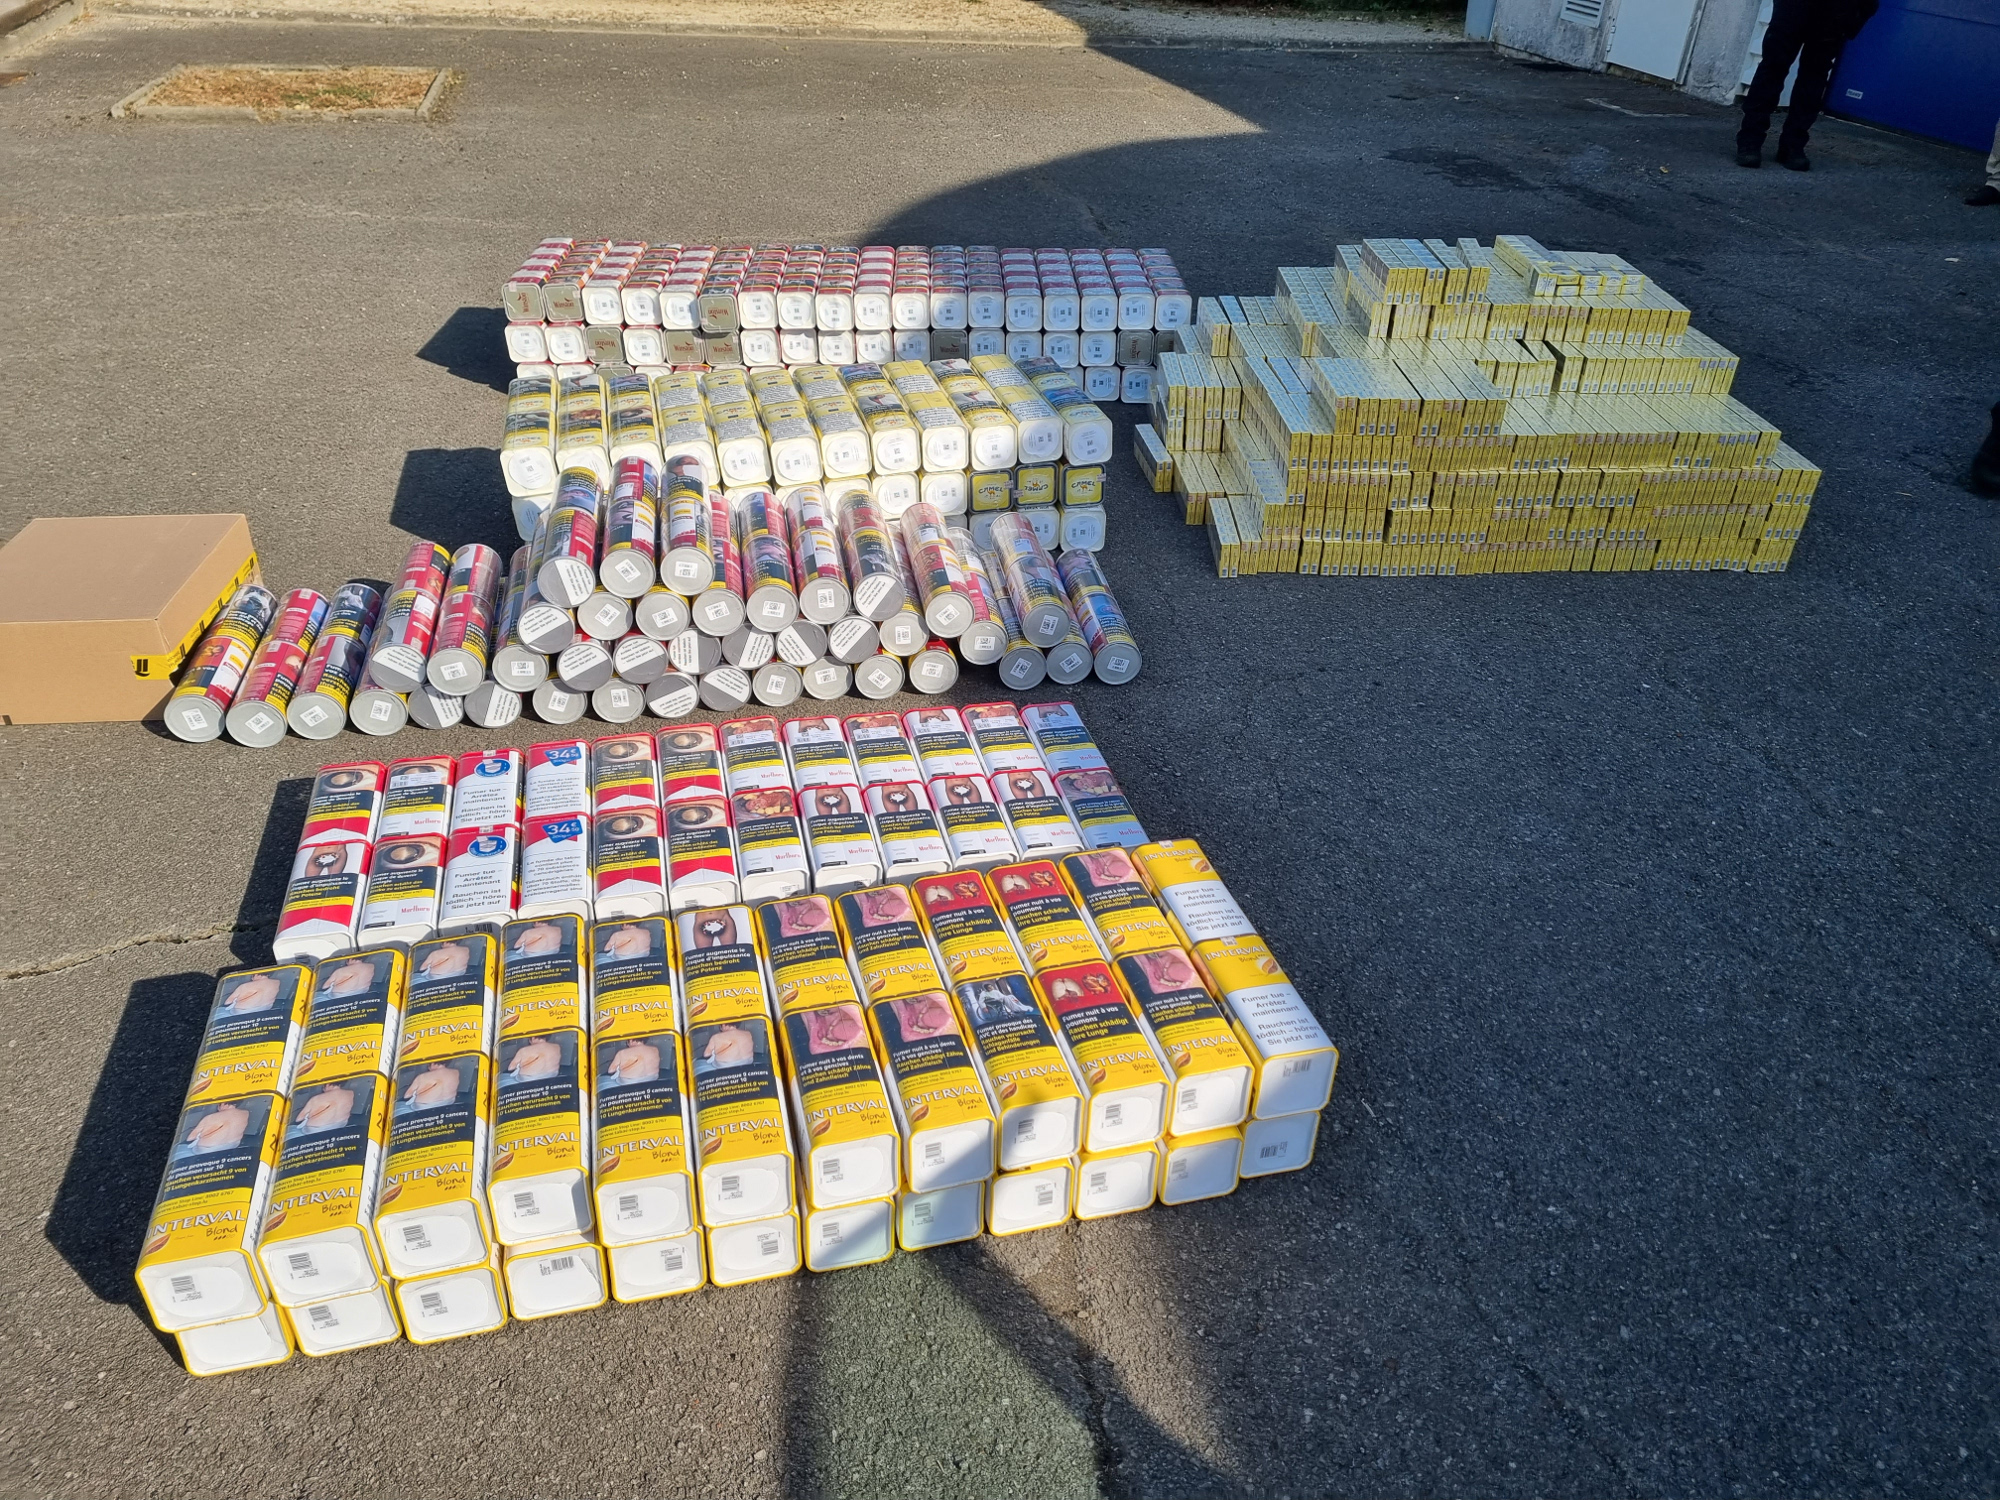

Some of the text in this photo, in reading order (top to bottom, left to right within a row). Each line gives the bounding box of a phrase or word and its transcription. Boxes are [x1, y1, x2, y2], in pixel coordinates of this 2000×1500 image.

[549, 750, 570, 759] 34
[548, 824, 570, 834] 34
[1144, 848, 1200, 862] INTERVAL
[1174, 888, 1199, 897] Fumer
[1183, 898, 1227, 908] maintenant
[1188, 910, 1222, 919] Rauchen
[1102, 920, 1166, 938] INTERVAL
[1196, 924, 1209, 932] Sie
[1025, 934, 1090, 953] INTERVAL
[945, 945, 1014, 965] INTERVAL
[1205, 945, 1265, 961] INTERVAL
[863, 962, 934, 983] INTERVAL
[778, 973, 850, 994] INTERVAL
[687, 986, 762, 1005] INTERVAL
[1241, 994, 1268, 1003] Fumer
[595, 1001, 672, 1019] INTERVAL
[1256, 999, 1287, 1009] Arrêtez
[1062, 1013, 1084, 1022] Fumer
[1086, 1009, 1100, 1018] nuit
[1252, 1006, 1300, 1018] maintenant
[1065, 1016, 1097, 1029] poumons
[1099, 1018, 1129, 1028] schädigt
[1258, 1020, 1296, 1030] Rauchen
[1087, 1028, 1108, 1039] Lunge
[1256, 1025, 1319, 1040] tödlich hören
[1267, 1032, 1319, 1046] Sie jetzt auf
[302, 1040, 380, 1062] NTERVAL
[1166, 1035, 1237, 1056] INTERVAL
[1081, 1050, 1155, 1073] INTERVAL
[194, 1059, 279, 1081] NTERVAL
[992, 1063, 1067, 1087] INTERVAL
[905, 1085, 982, 1109] INTERVAL
[957, 1097, 983, 1107] Blond
[807, 1099, 888, 1123] INTERVAL
[860, 1111, 887, 1122] Blond
[700, 1117, 783, 1141] INTERVAL
[753, 1131, 780, 1141] Blond
[492, 1131, 579, 1156] INTERVAL
[547, 1144, 575, 1155] Blond
[597, 1135, 684, 1160] INTERVAL
[652, 1149, 680, 1160] Blond
[381, 1162, 471, 1189] INTERVAL
[436, 1175, 466, 1187] Blond
[321, 1200, 352, 1214] Blond
[206, 1224, 238, 1236] Blond
